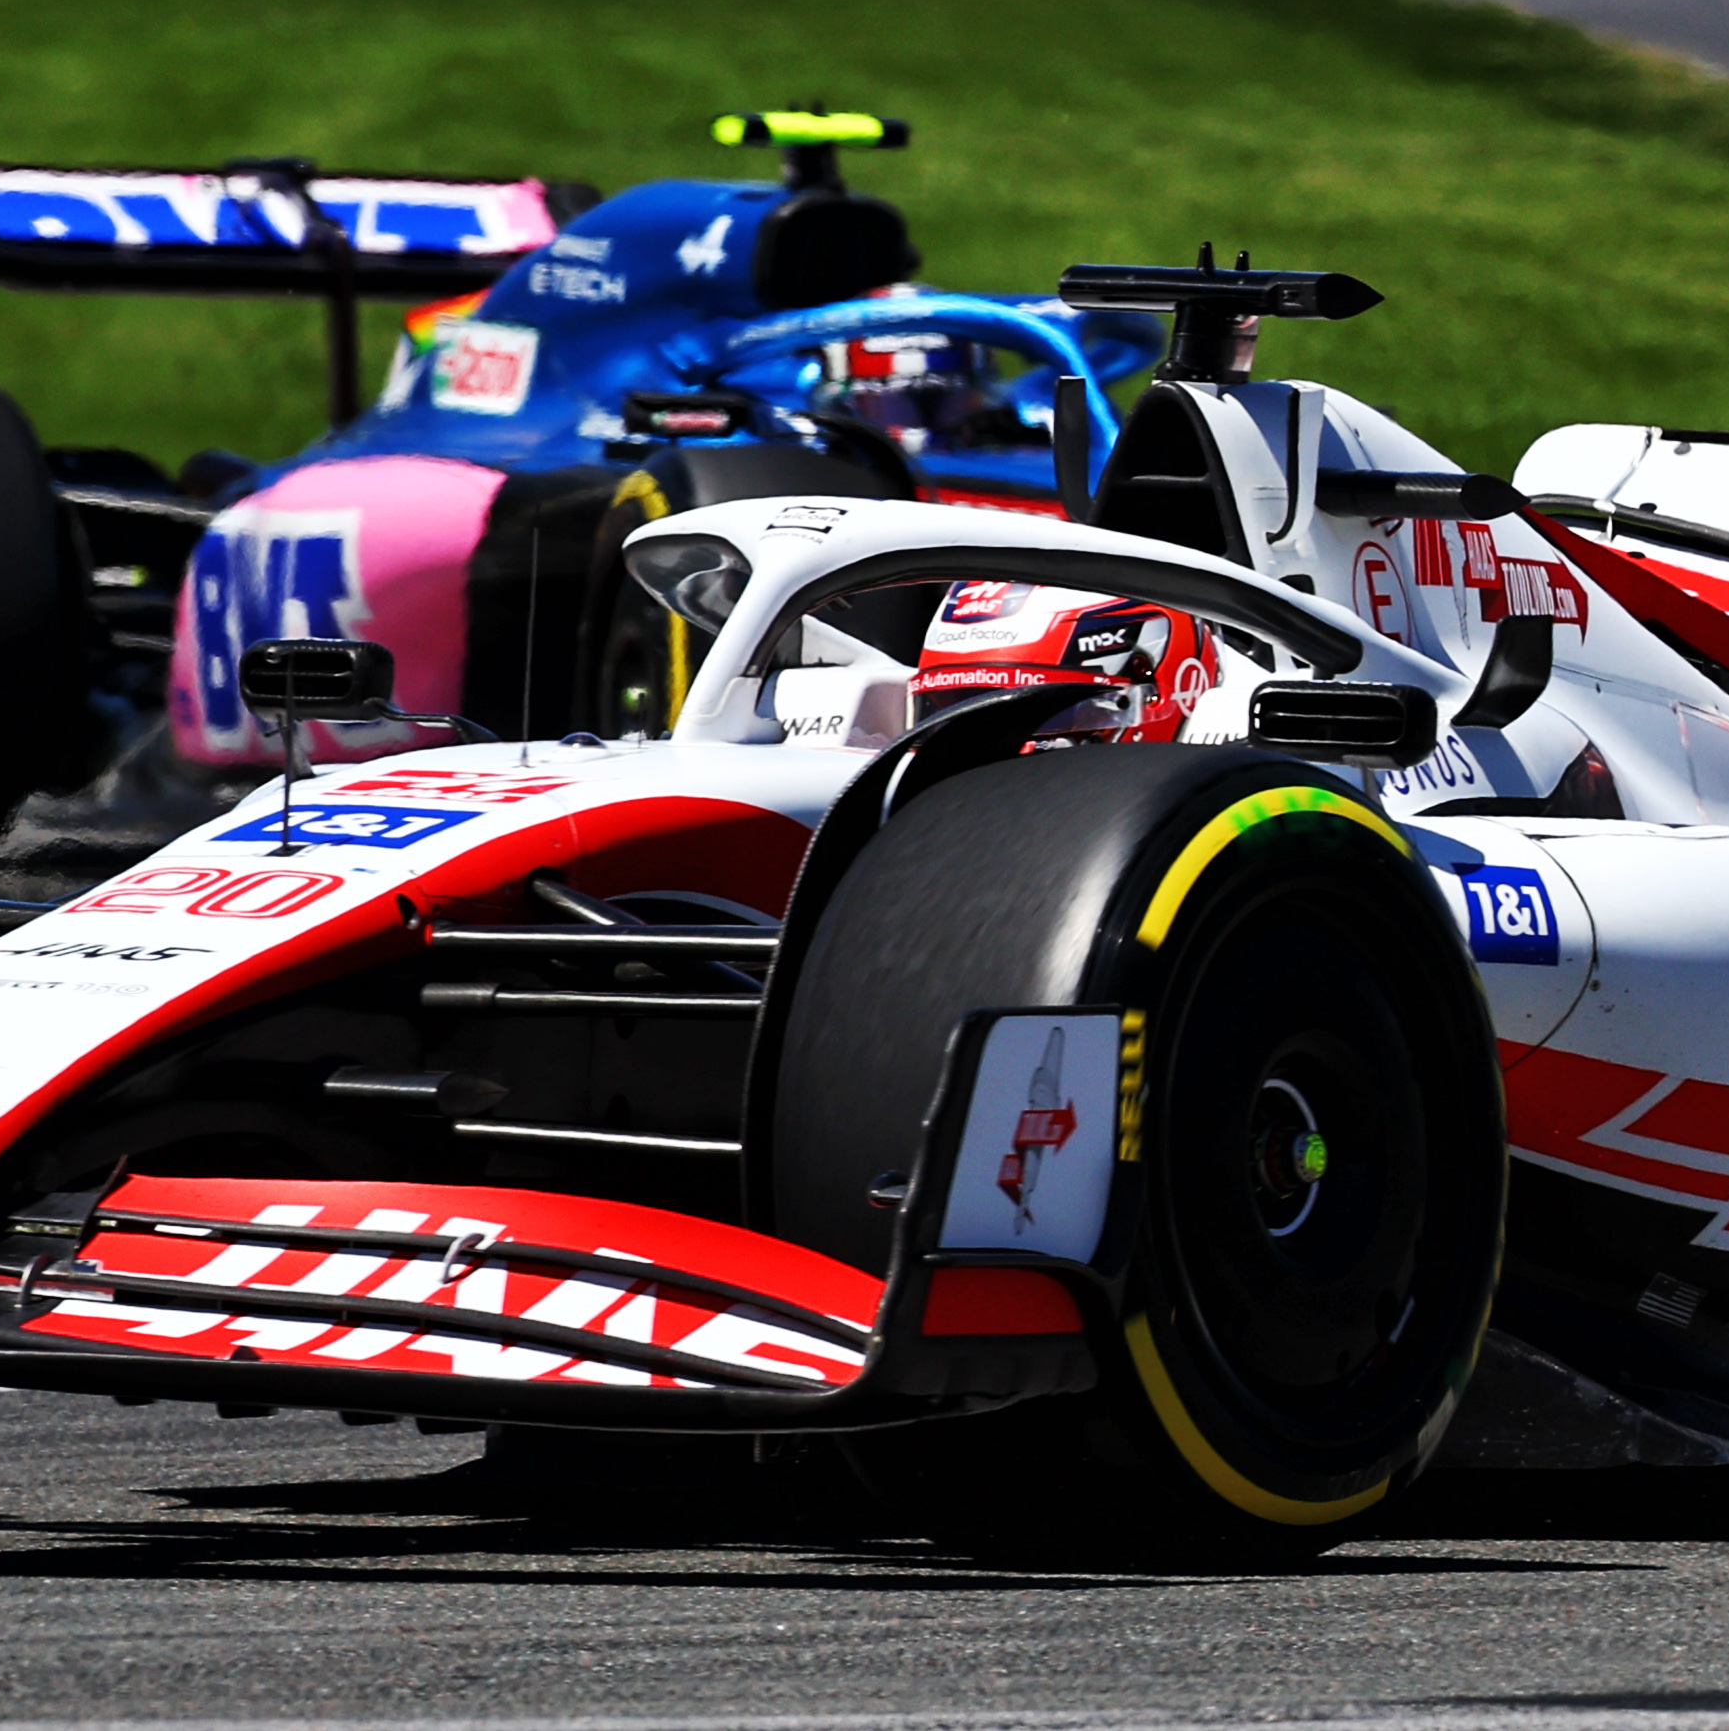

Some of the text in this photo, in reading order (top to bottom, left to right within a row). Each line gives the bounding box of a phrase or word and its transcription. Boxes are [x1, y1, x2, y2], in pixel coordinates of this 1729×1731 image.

[921, 668, 1009, 689] Automation
[1014, 668, 1046, 687] Inc
[60, 866, 346, 919] 20
[1468, 881, 1550, 938] 1&1
